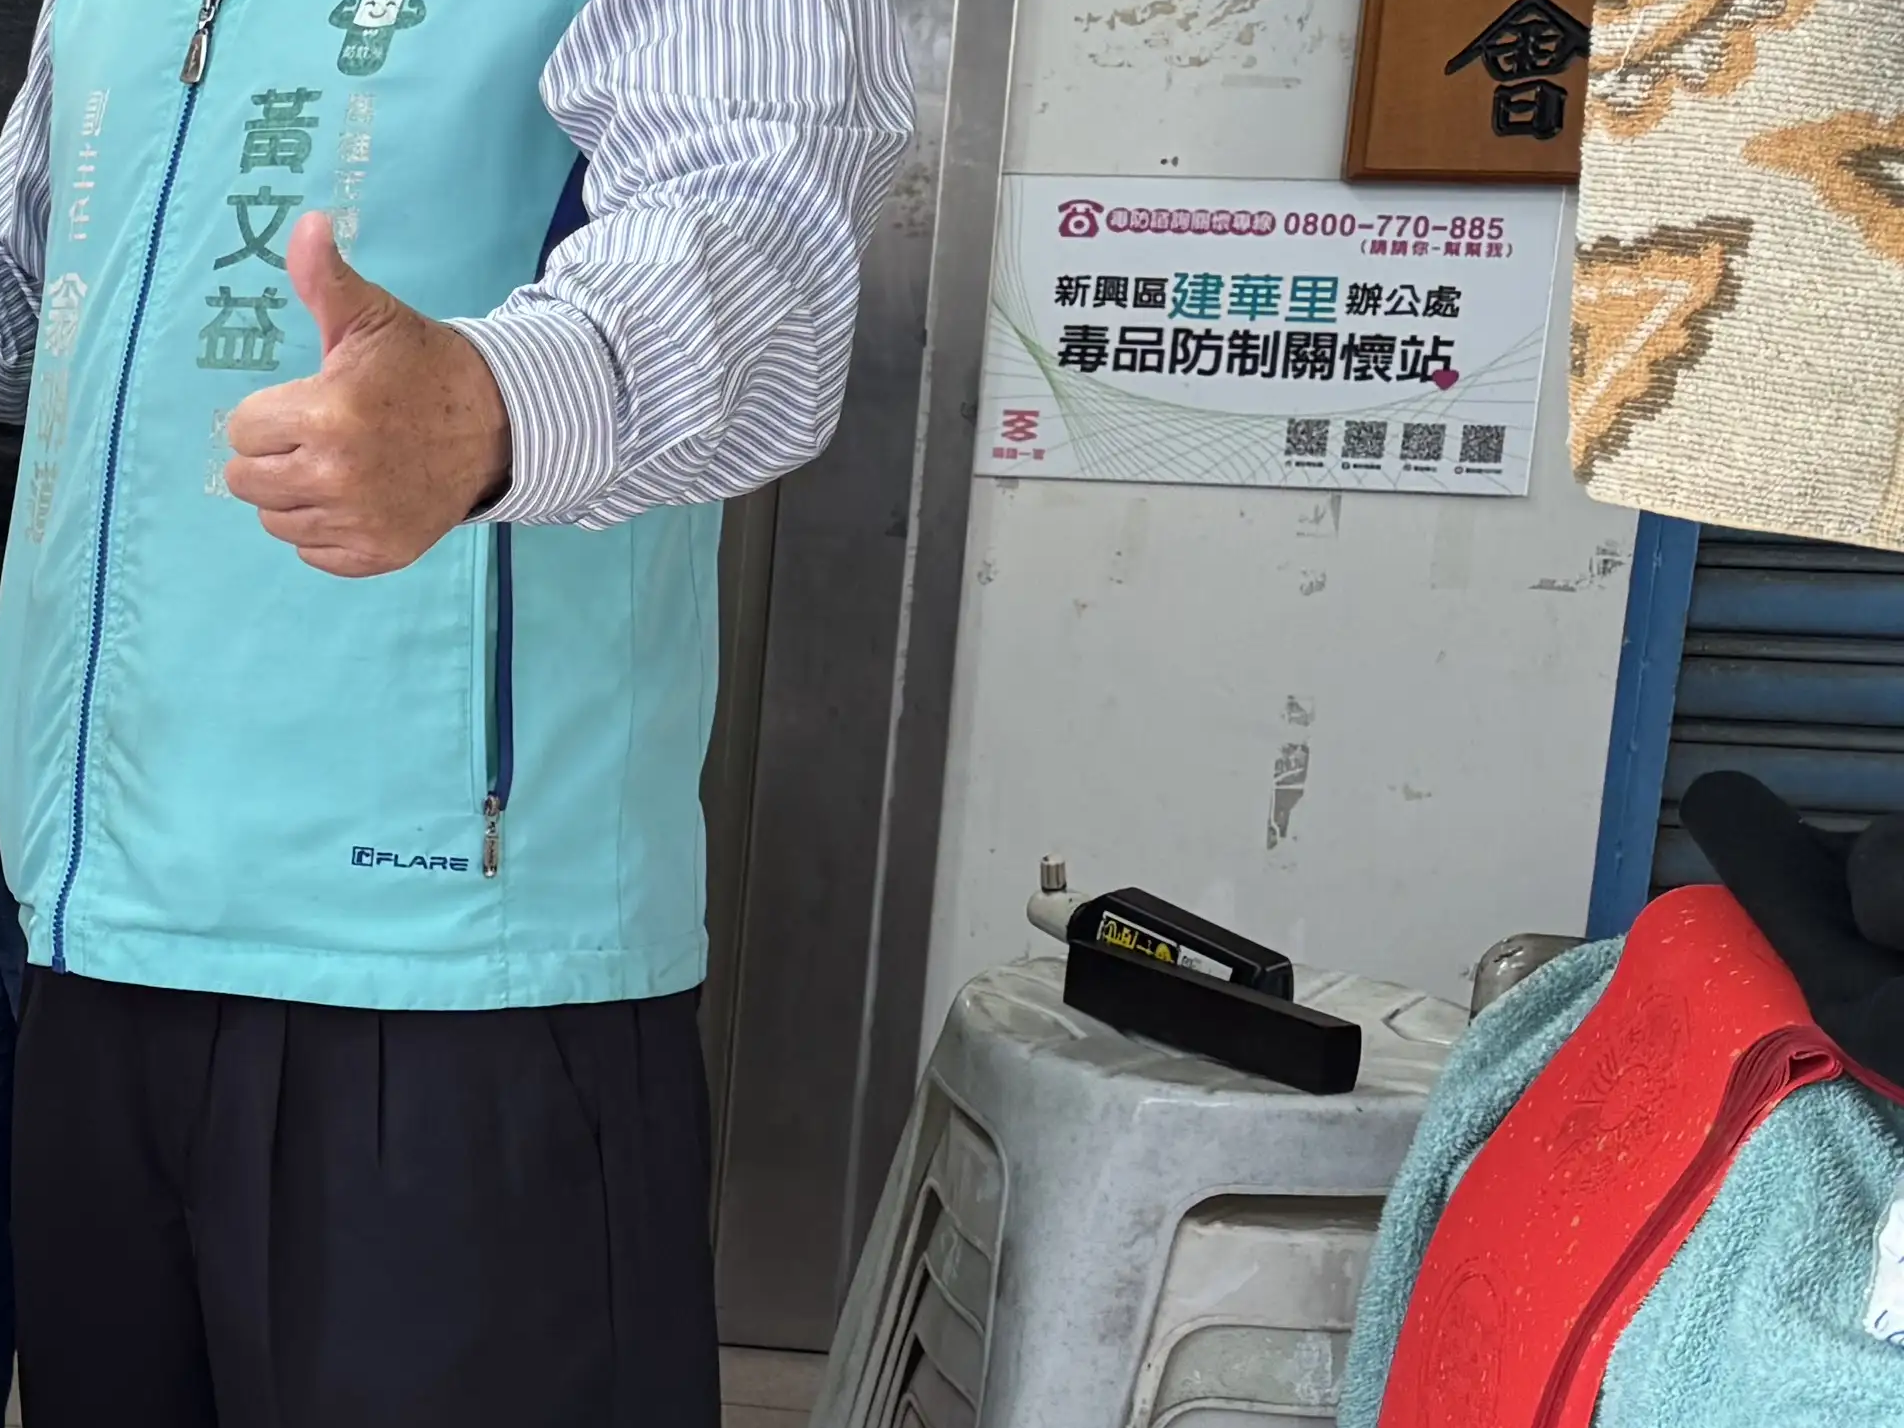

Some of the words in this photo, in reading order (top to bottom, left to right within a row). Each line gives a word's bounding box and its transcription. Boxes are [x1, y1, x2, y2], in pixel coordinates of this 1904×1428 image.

[196, 86, 323, 371] 黃文益
[1284, 212, 1505, 241] 0800-770-885
[1054, 272, 1462, 325] 新興區建華里辦公處
[1056, 323, 1457, 385] 毒品防制關懷站
